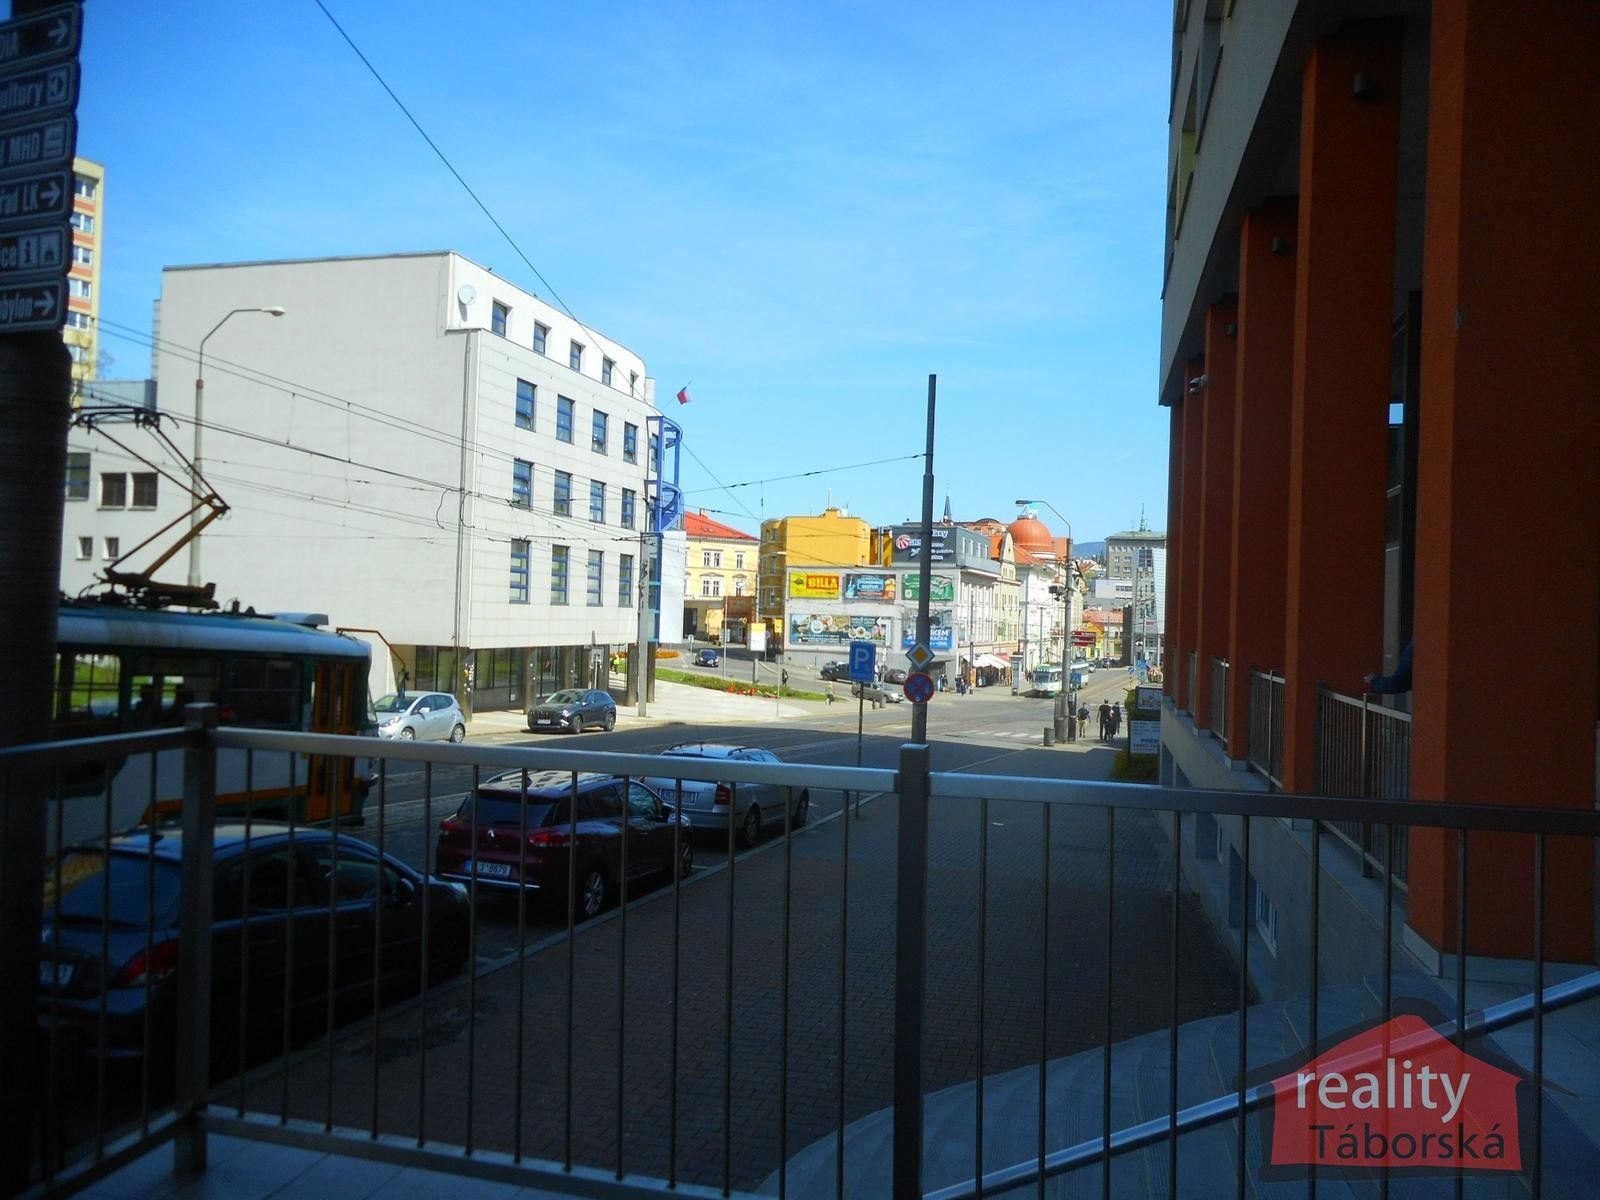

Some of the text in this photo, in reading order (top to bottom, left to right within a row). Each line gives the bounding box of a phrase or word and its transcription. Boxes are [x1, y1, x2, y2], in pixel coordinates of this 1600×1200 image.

[9, 132, 40, 164] MHD
[22, 183, 39, 211] LK
[808, 577, 838, 589] BILLA
[854, 647, 870, 671] P
